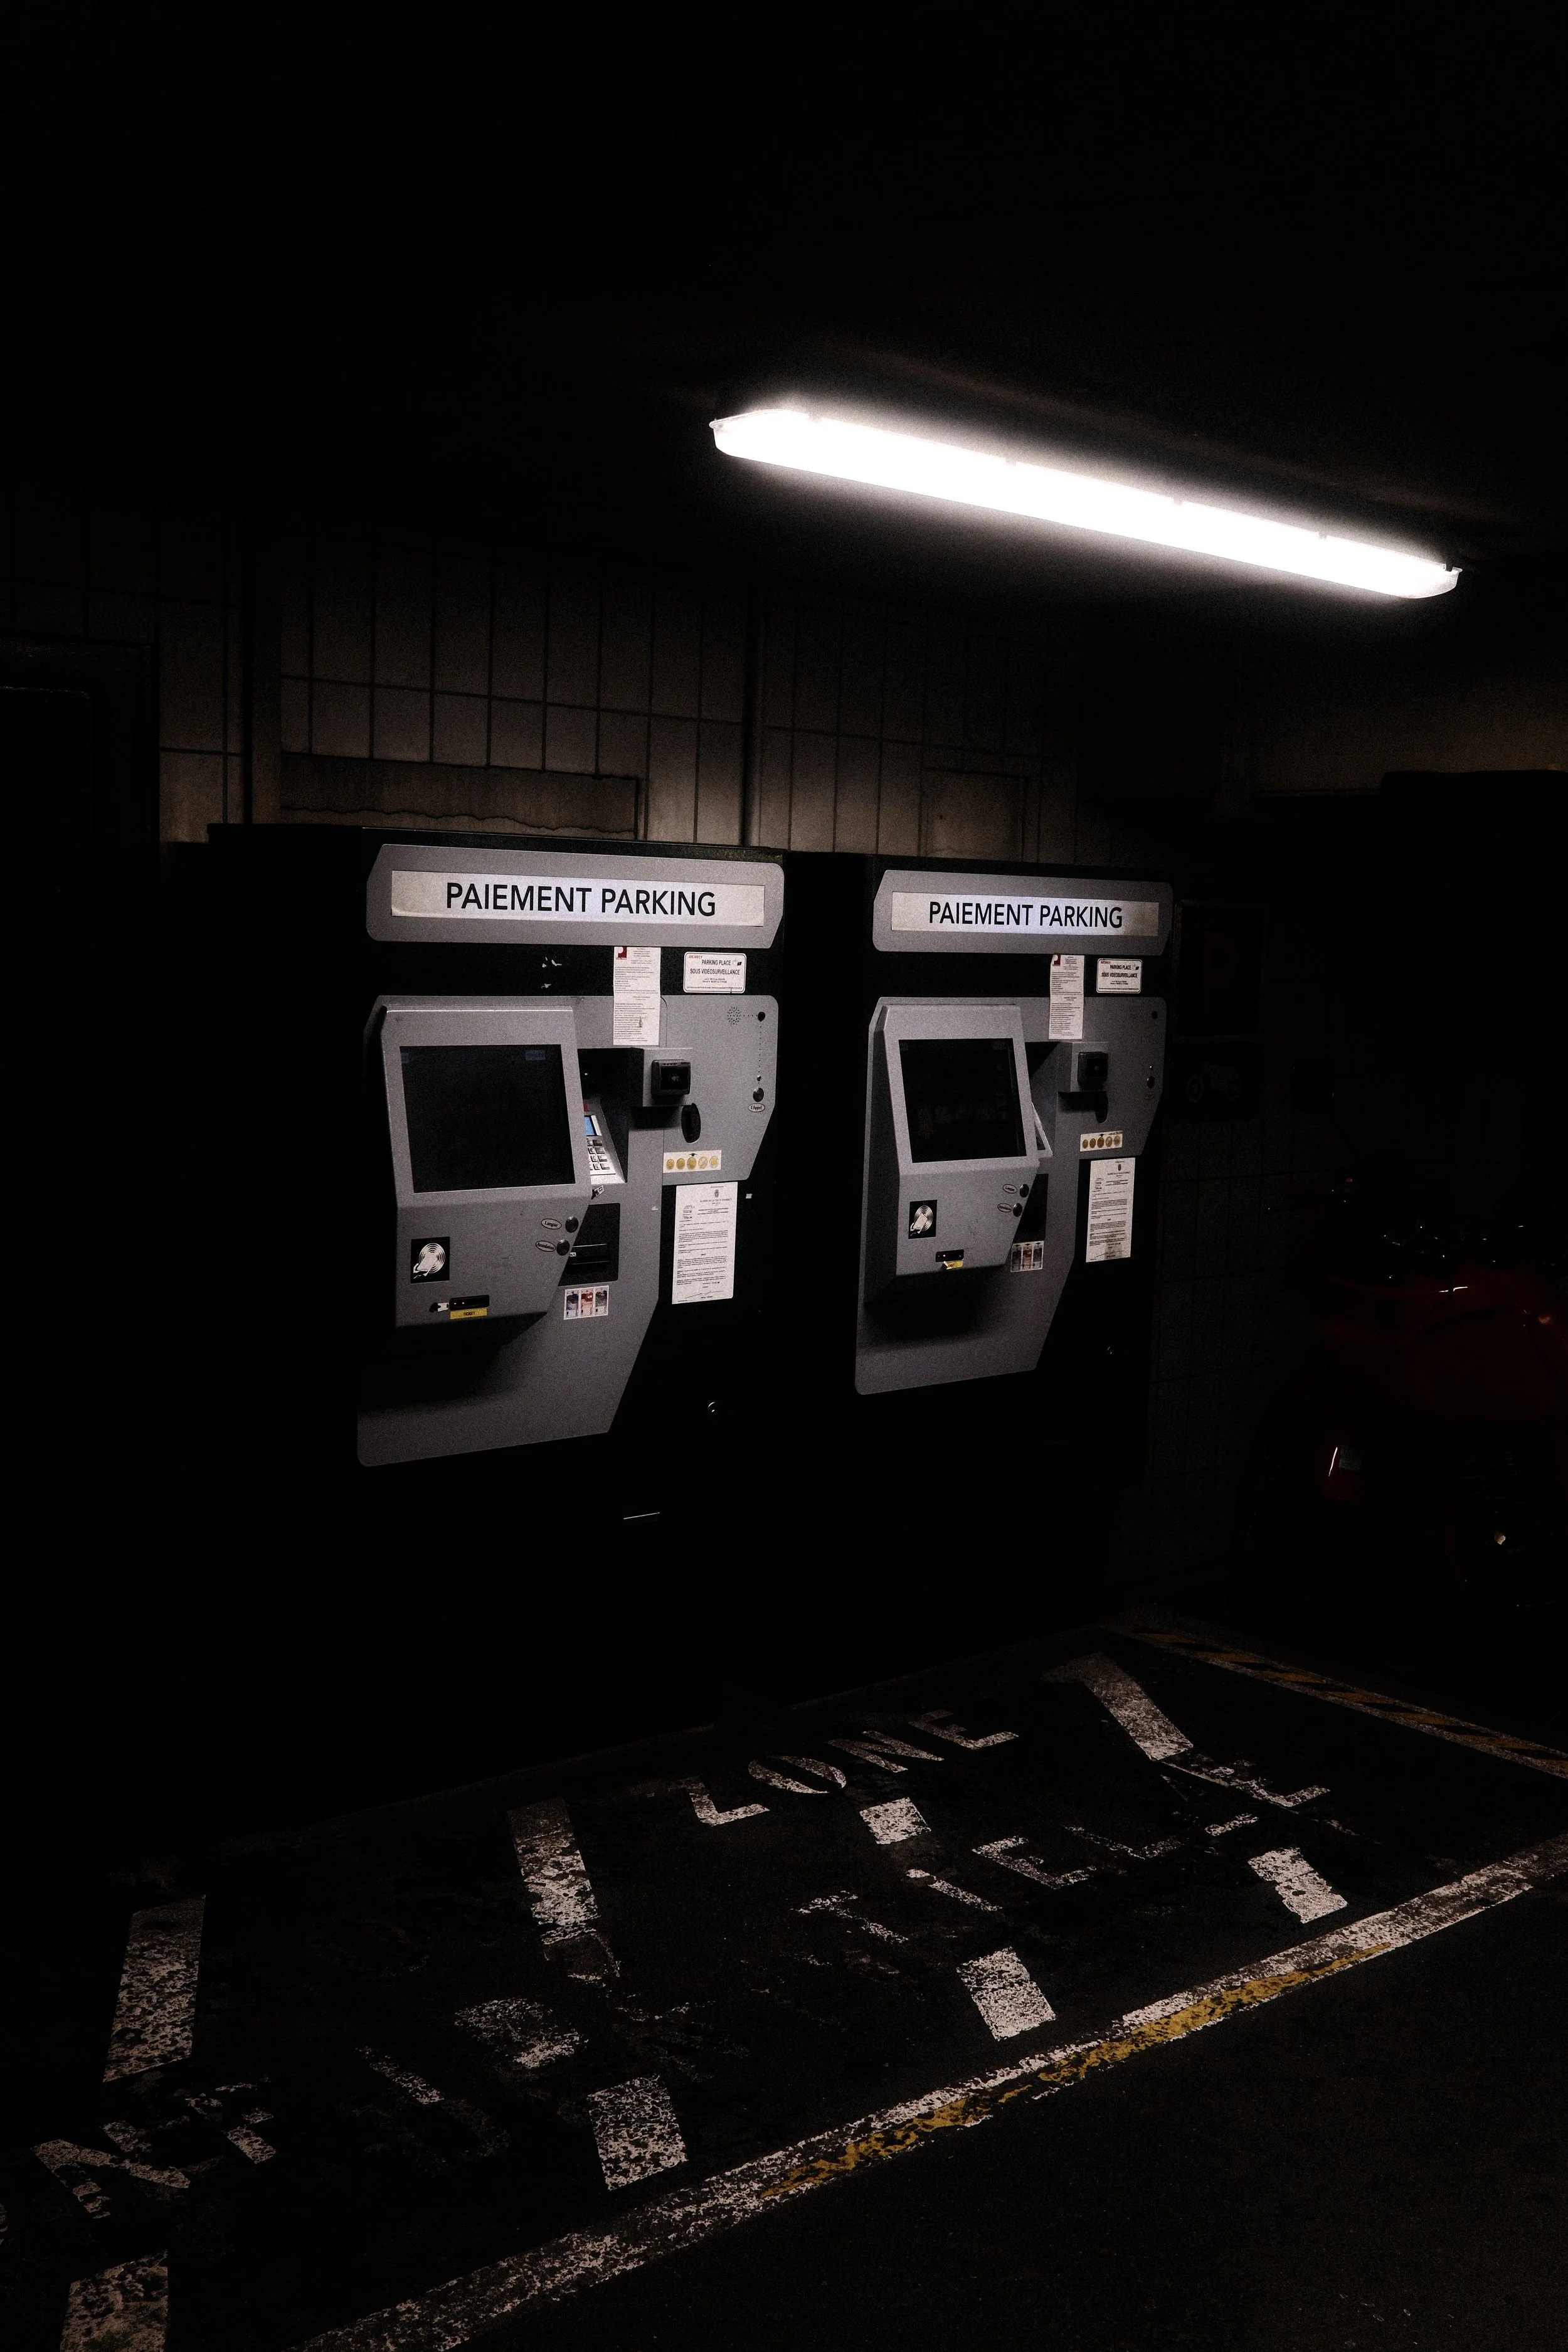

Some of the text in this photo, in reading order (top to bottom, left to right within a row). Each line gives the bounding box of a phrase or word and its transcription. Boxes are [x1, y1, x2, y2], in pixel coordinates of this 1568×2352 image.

[446, 882, 716, 916] PAIEMENT PARKING
[929, 901, 1123, 928] PAIEMENT PARKING
